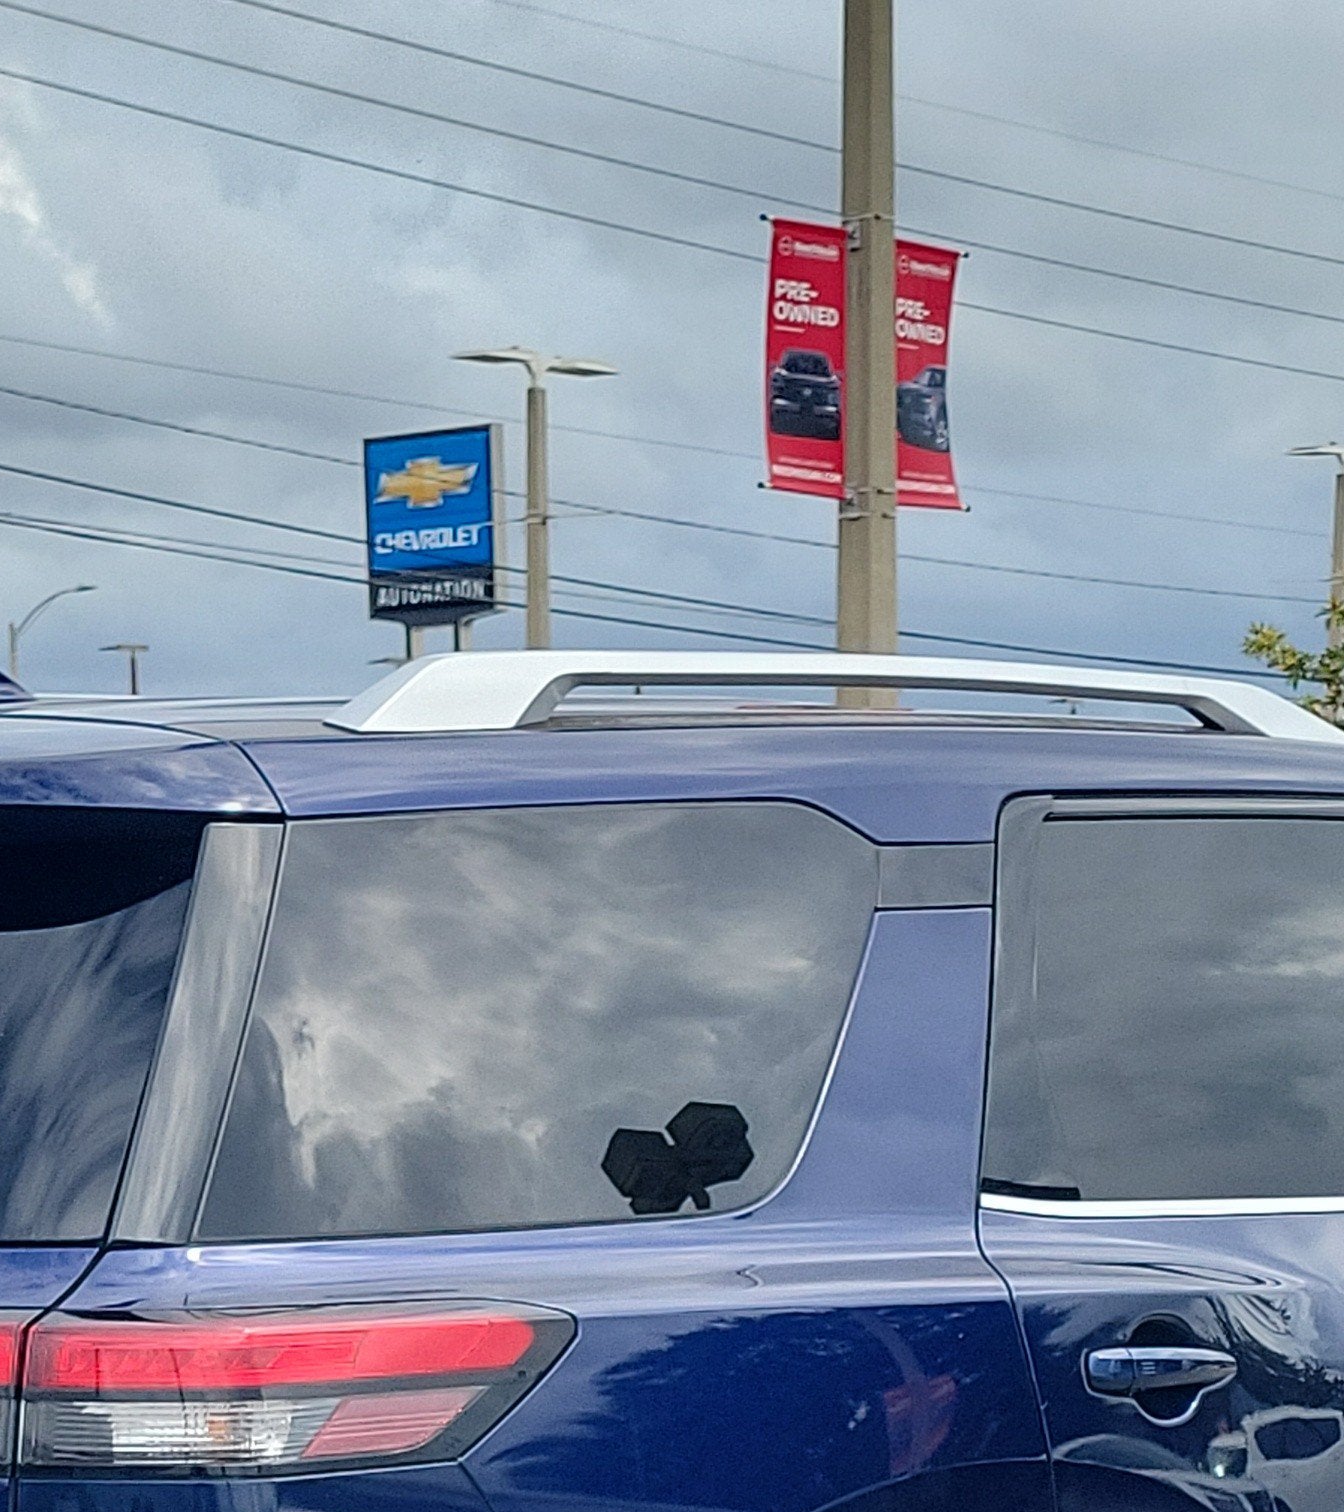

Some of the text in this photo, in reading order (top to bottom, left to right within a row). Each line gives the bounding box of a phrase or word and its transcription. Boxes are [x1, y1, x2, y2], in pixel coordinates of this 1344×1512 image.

[774, 278, 820, 302] PRE-
[773, 300, 840, 328] OWNED
[895, 297, 931, 320] PRE-
[895, 318, 946, 346] OWNED
[374, 526, 480, 554] CHEVROLET
